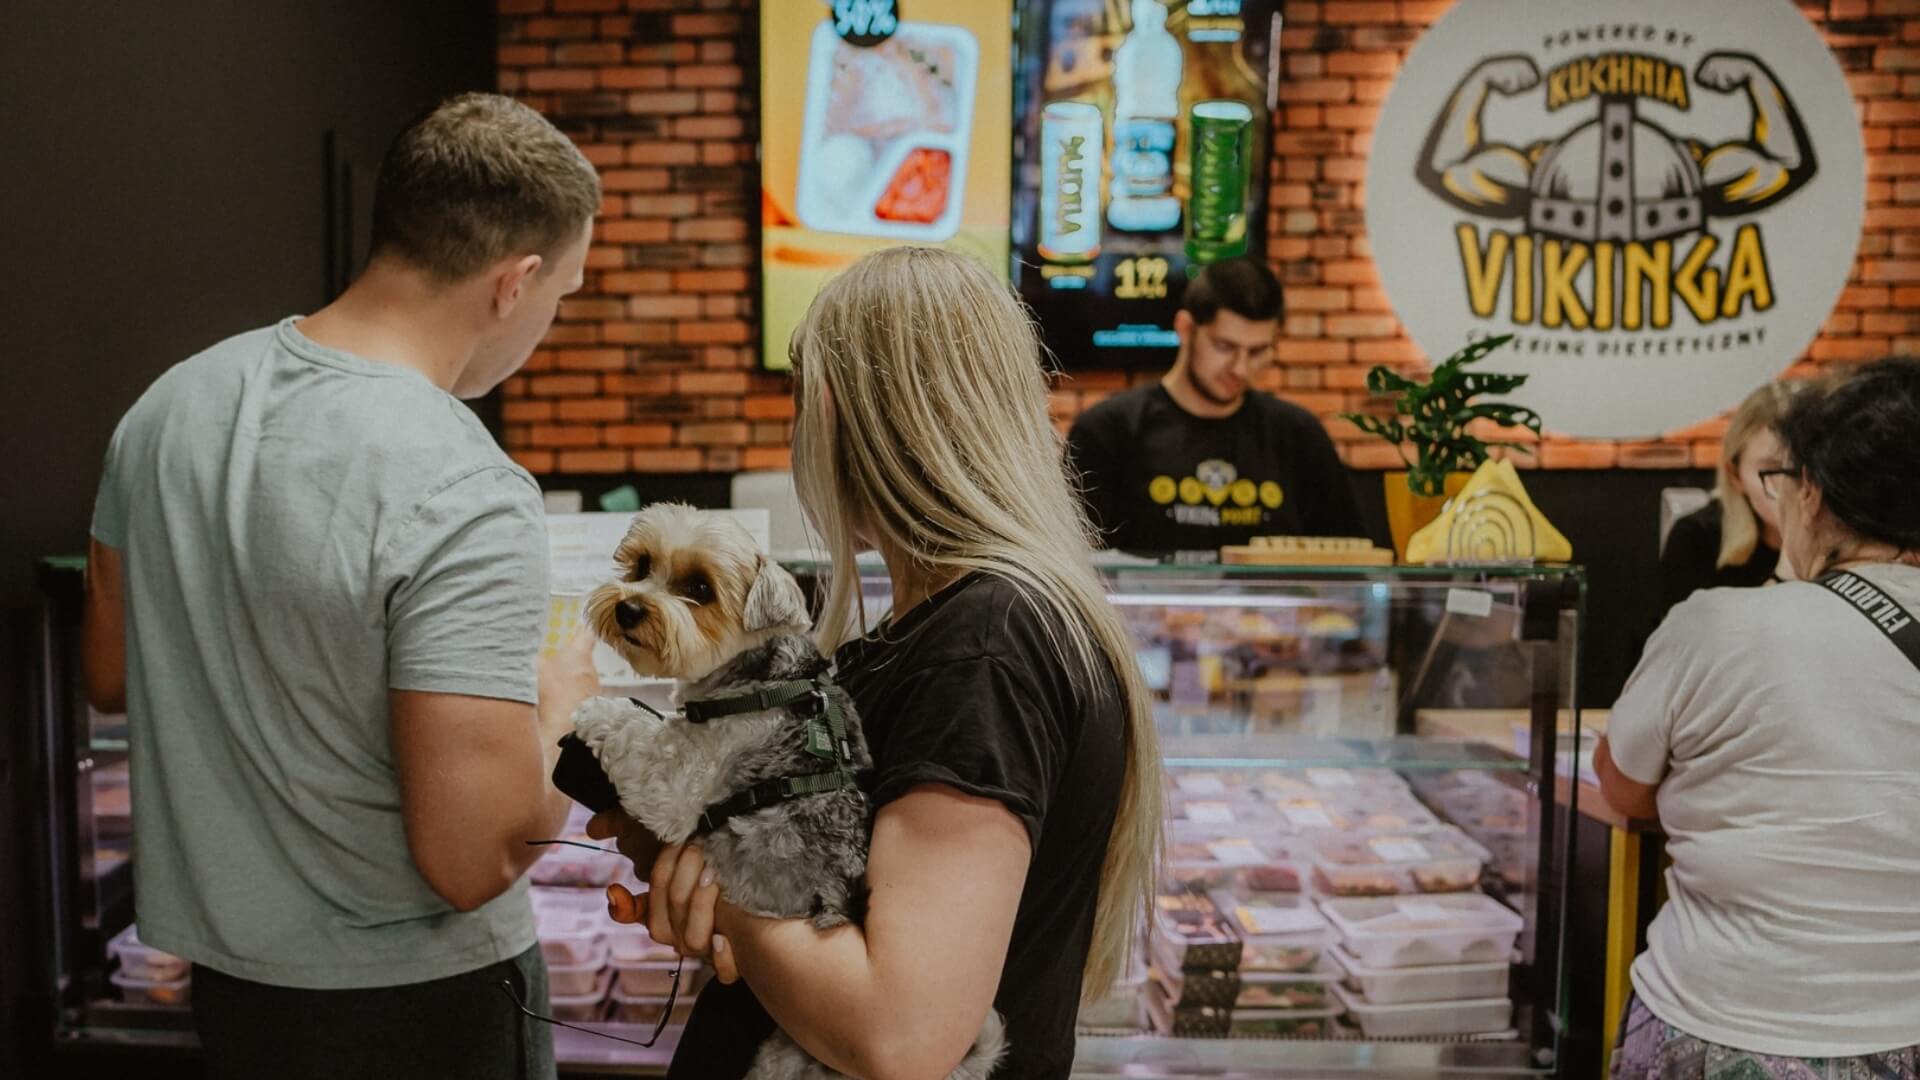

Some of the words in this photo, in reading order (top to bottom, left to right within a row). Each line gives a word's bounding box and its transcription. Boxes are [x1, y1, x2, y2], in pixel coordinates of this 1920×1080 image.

[1543, 23, 1656, 48] POWERED
[1665, 28, 1694, 47] BY
[1546, 53, 1691, 112] KUCHNIA
[1454, 222, 1776, 331] VIKINGA
